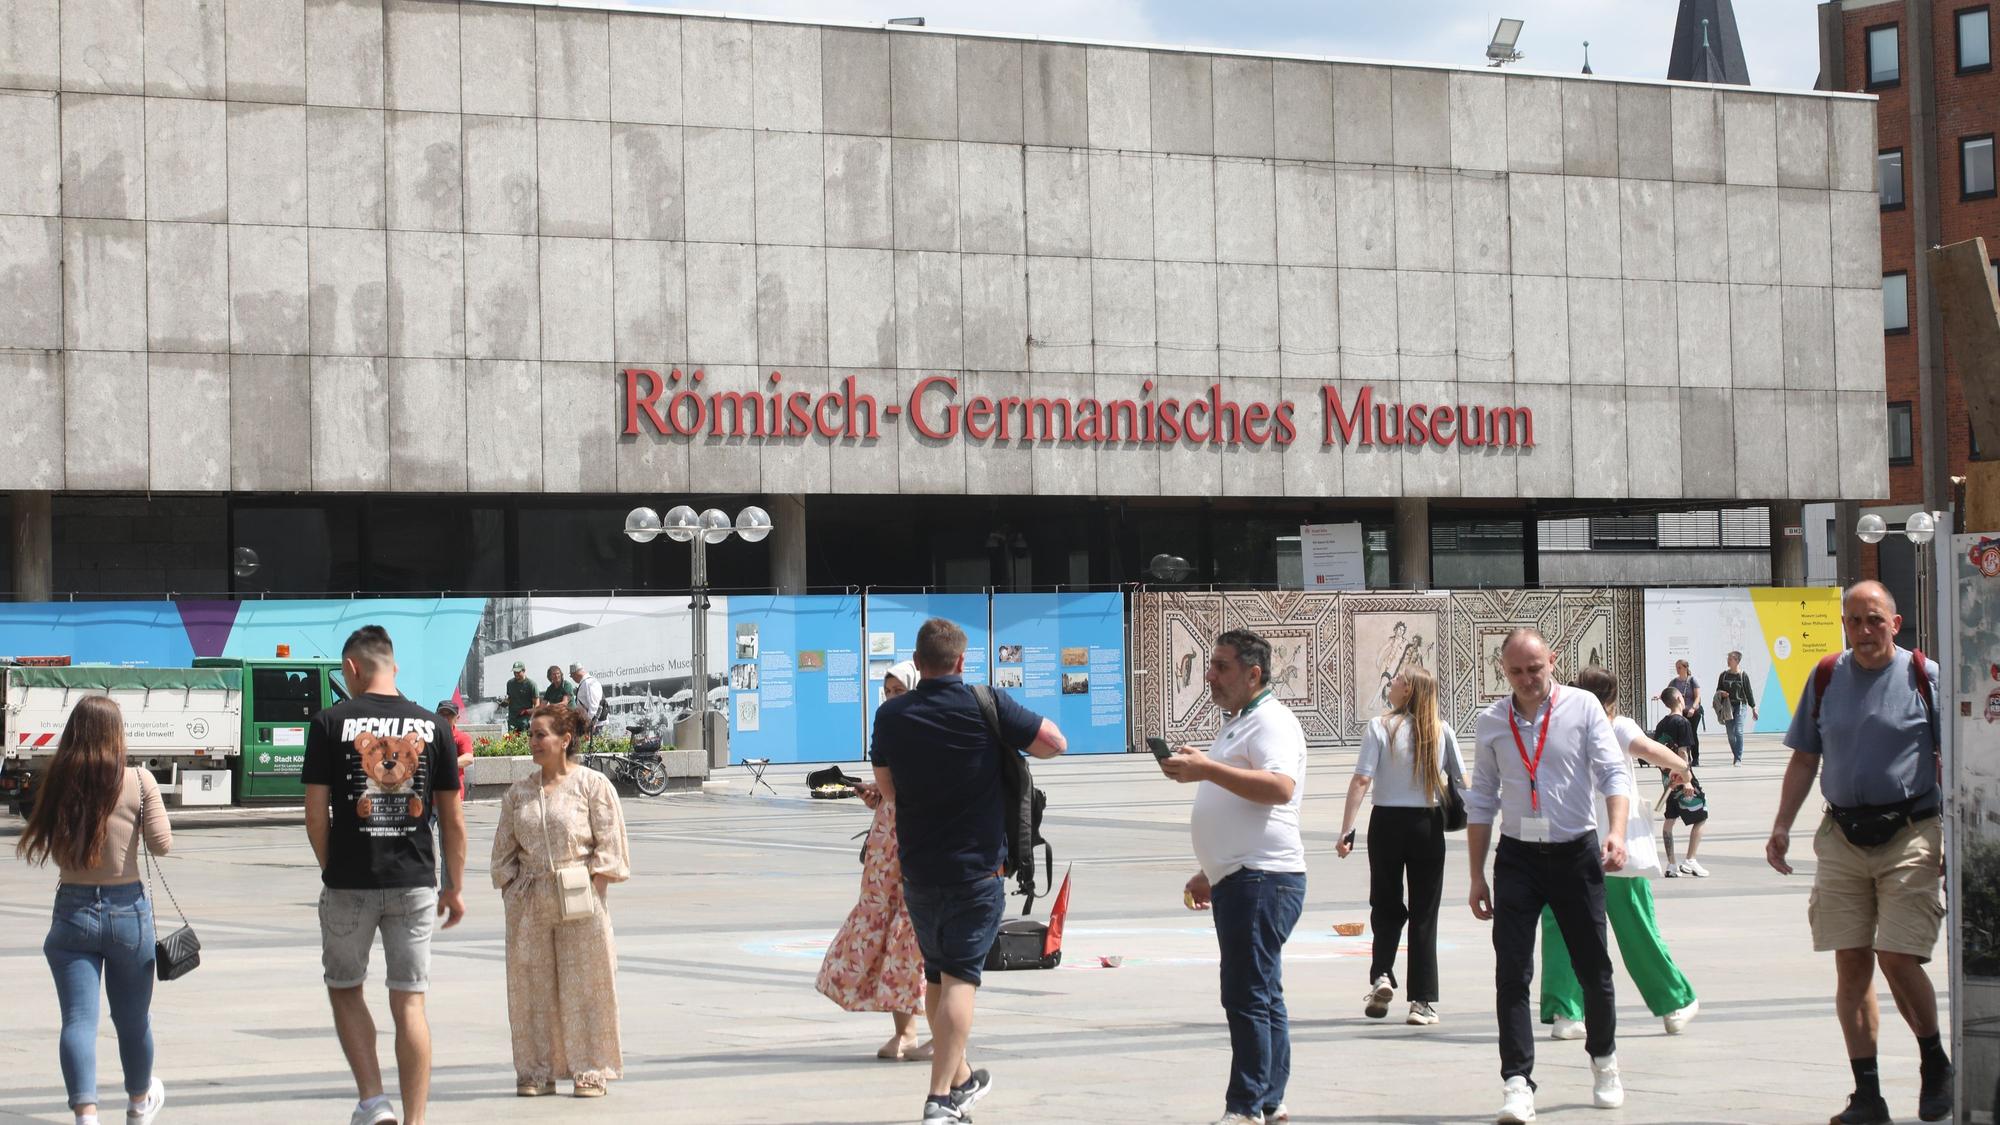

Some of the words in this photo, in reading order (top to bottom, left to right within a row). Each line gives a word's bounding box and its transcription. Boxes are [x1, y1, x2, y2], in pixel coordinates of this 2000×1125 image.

[622, 368, 1297, 447] Römisch-Germanisches
[1322, 384, 1535, 448] Museum
[668, 658, 693, 671] Muse
[341, 717, 436, 743] RECKLESS
[274, 755, 292, 763] Stadt
[293, 755, 305, 763] Köl
